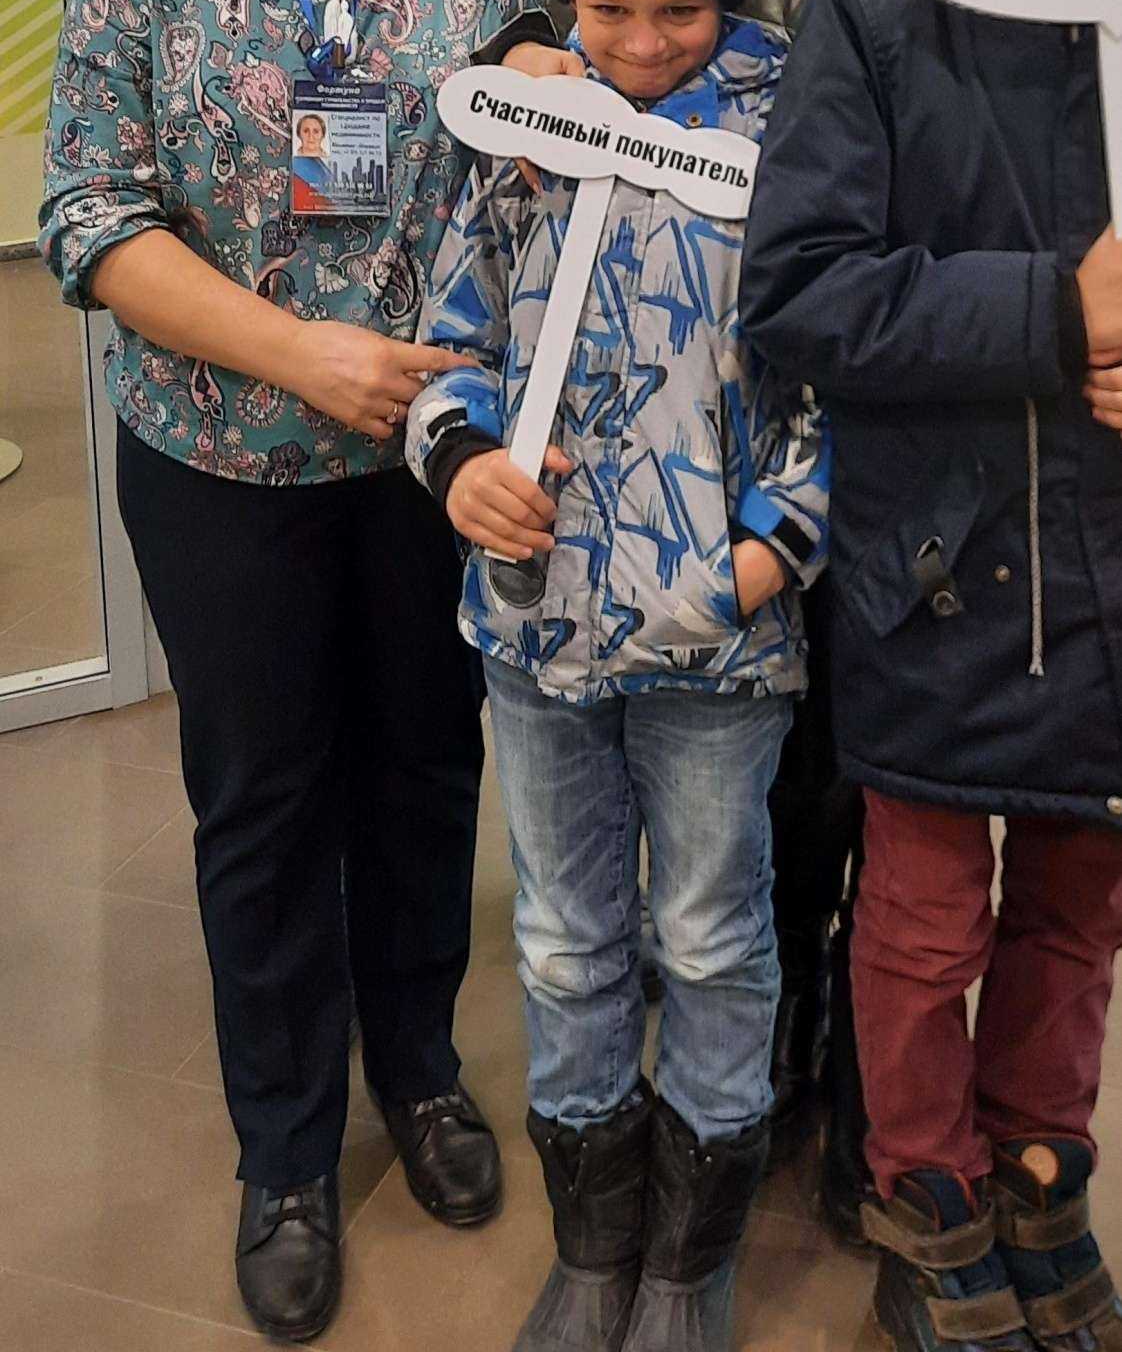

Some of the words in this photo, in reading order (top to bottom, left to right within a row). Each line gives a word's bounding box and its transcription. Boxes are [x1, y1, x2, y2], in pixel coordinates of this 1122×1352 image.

[317, 84, 360, 95] Фортуна
[470, 90, 611, 149] Счастливый
[615, 134, 748, 188] покупатель
